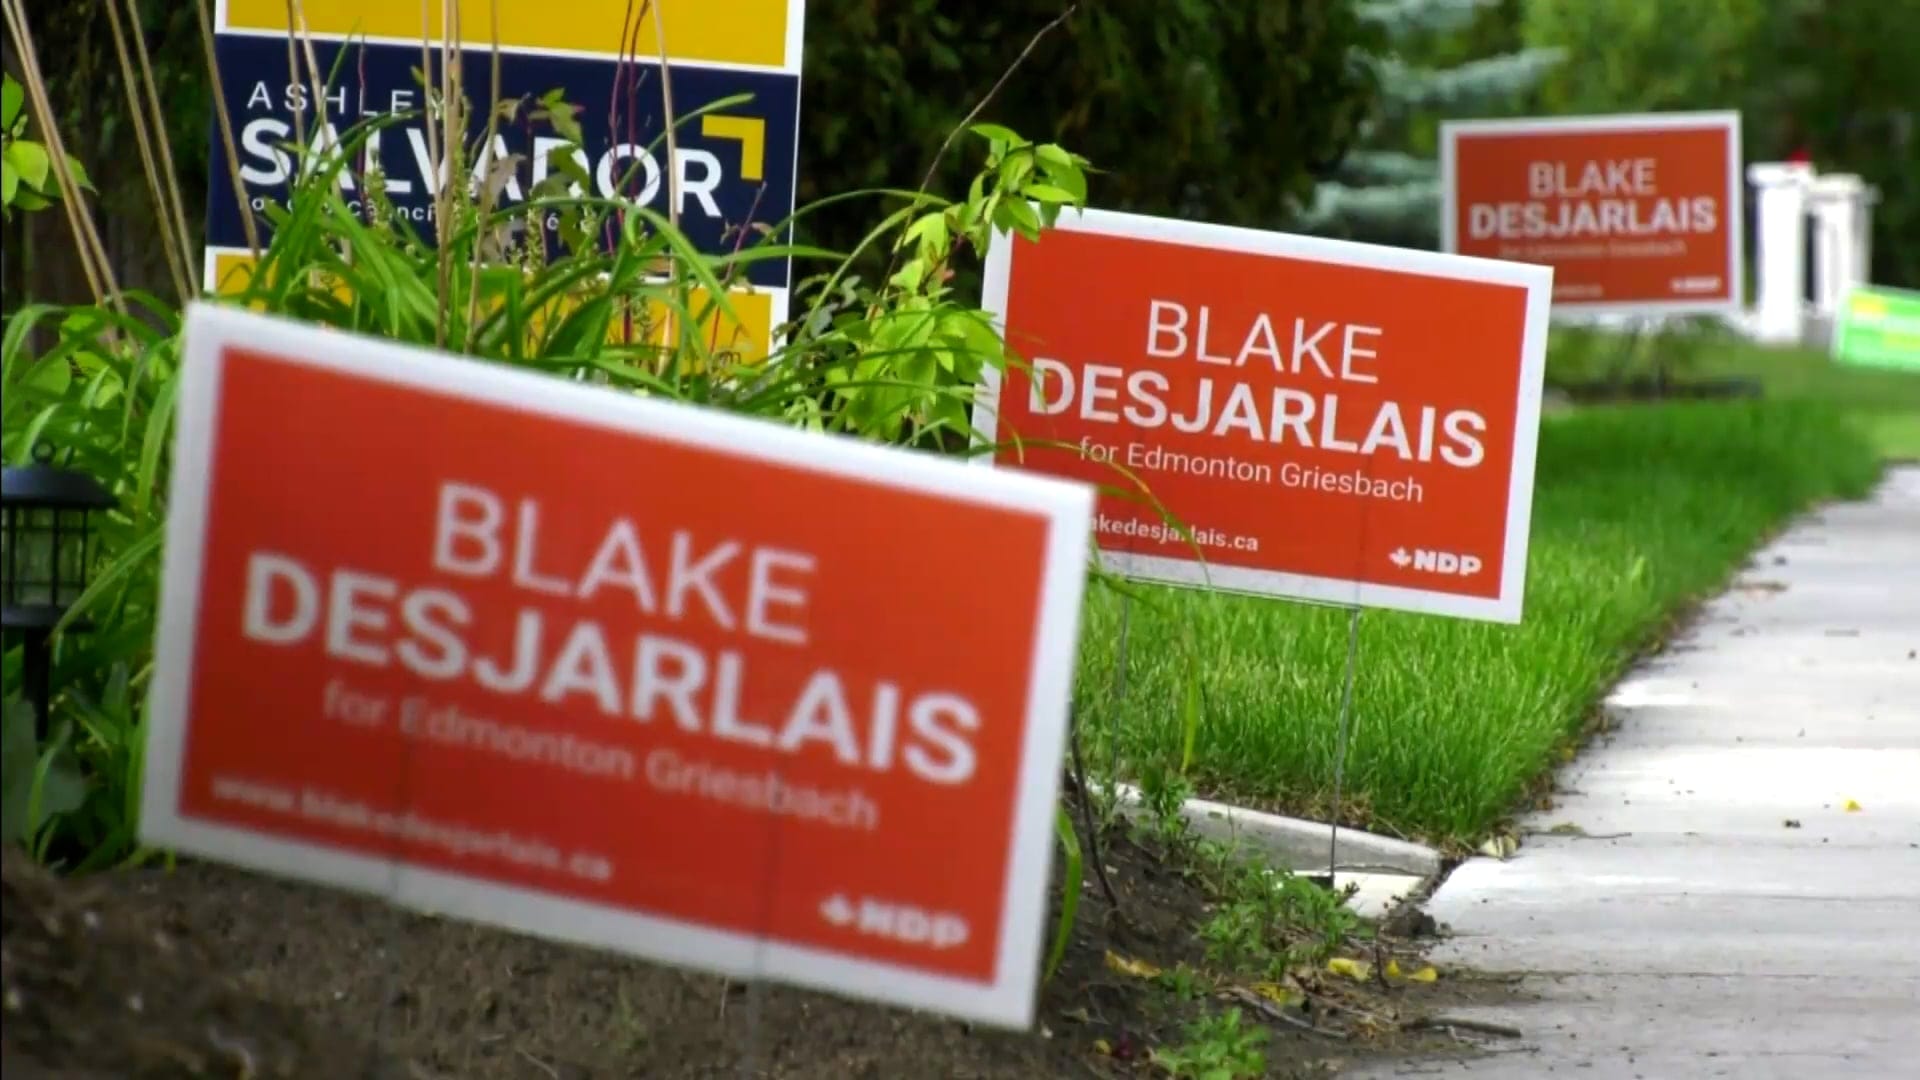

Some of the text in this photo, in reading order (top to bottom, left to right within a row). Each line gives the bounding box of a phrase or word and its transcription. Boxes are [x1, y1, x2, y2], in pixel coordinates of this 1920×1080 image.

[1528, 157, 1657, 197] BLAKE
[1469, 195, 1718, 240] DESJARLAIS
[1146, 299, 1383, 384] BLAKE
[1028, 357, 1486, 468] DESJARLAIS
[1079, 436, 1423, 502] for Edmonton Griesbach
[431, 481, 818, 644] BLAKE
[1414, 549, 1482, 576] NDP
[242, 550, 983, 785] DESJARLAIS
[323, 678, 880, 831] for Edmonton Griesbach
[857, 896, 970, 950] NDP
